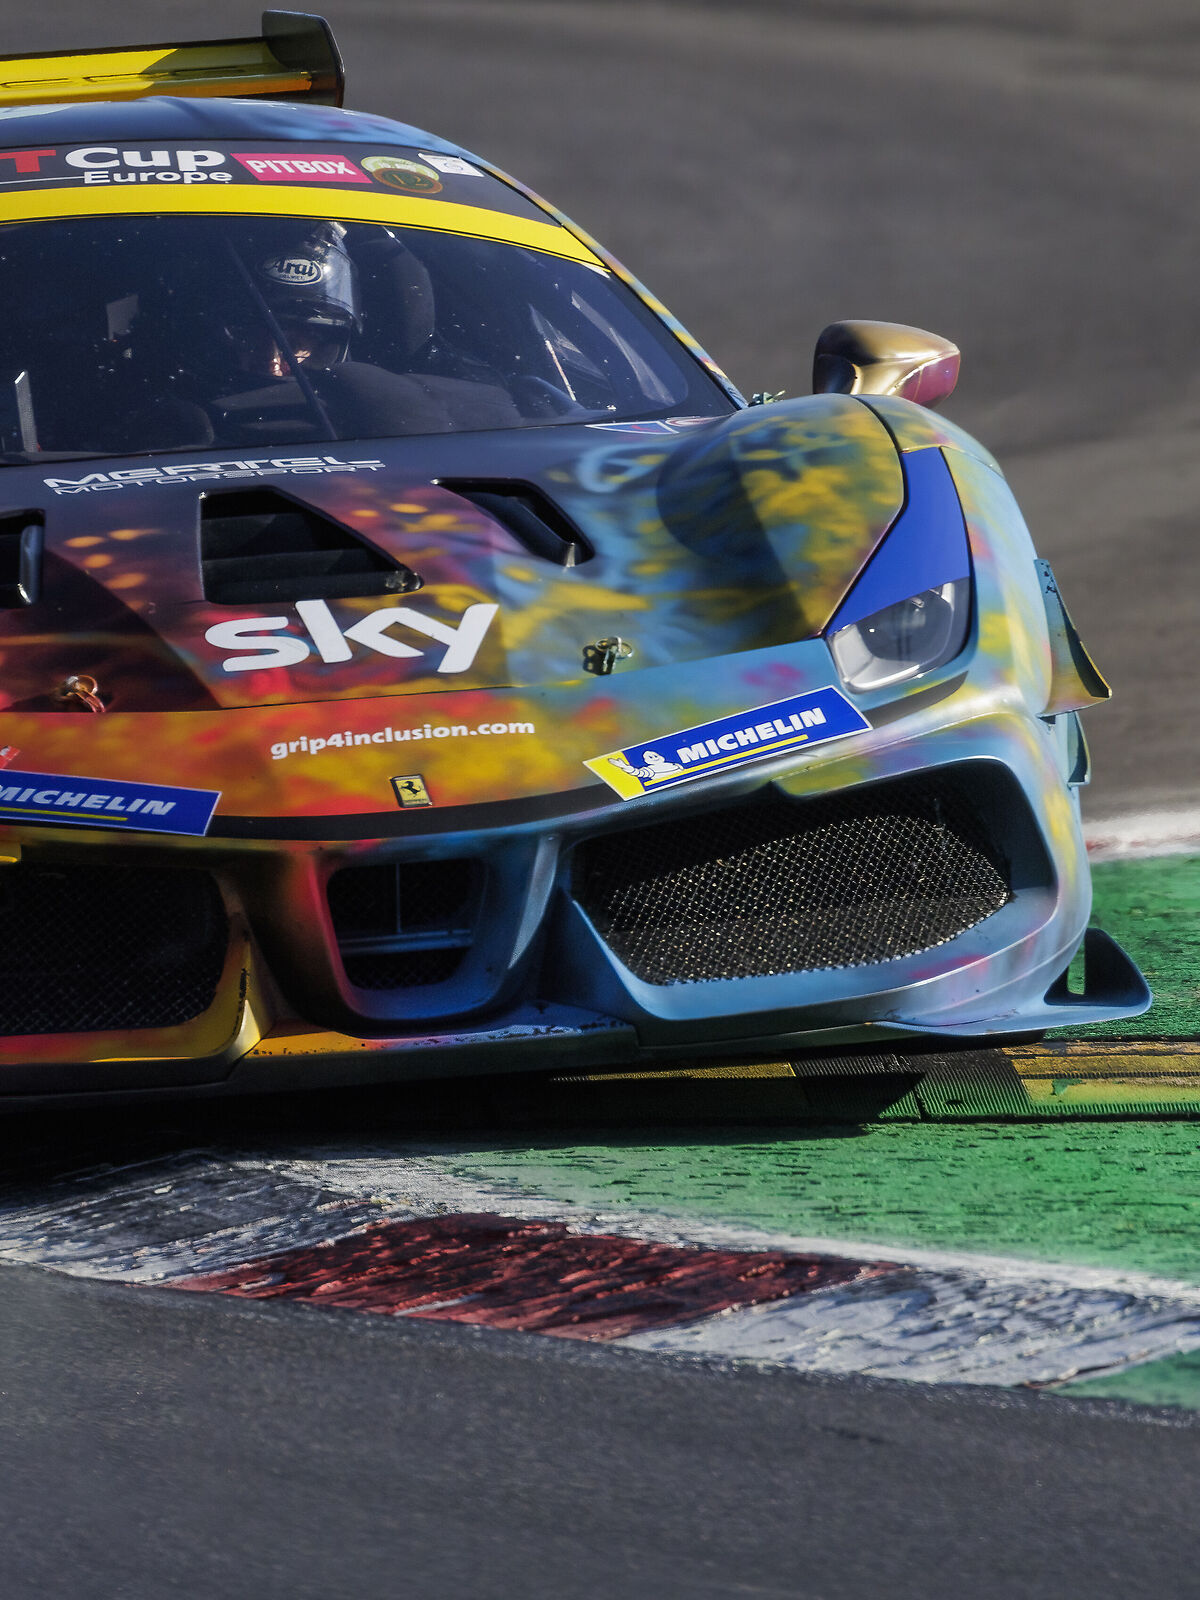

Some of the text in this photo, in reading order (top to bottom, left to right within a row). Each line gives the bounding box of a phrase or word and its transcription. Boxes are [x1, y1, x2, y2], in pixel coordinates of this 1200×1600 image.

[65, 146, 227, 173] Cup
[246, 158, 357, 177] PITBOX
[83, 168, 233, 185] Europe
[264, 258, 315, 276] Arai
[43, 456, 382, 489] MERTEL
[53, 463, 386, 495] MOTORSPORT
[204, 600, 499, 674] sky
[270, 718, 536, 760] grip4inclusion.com
[678, 706, 828, 765] MICHELIN
